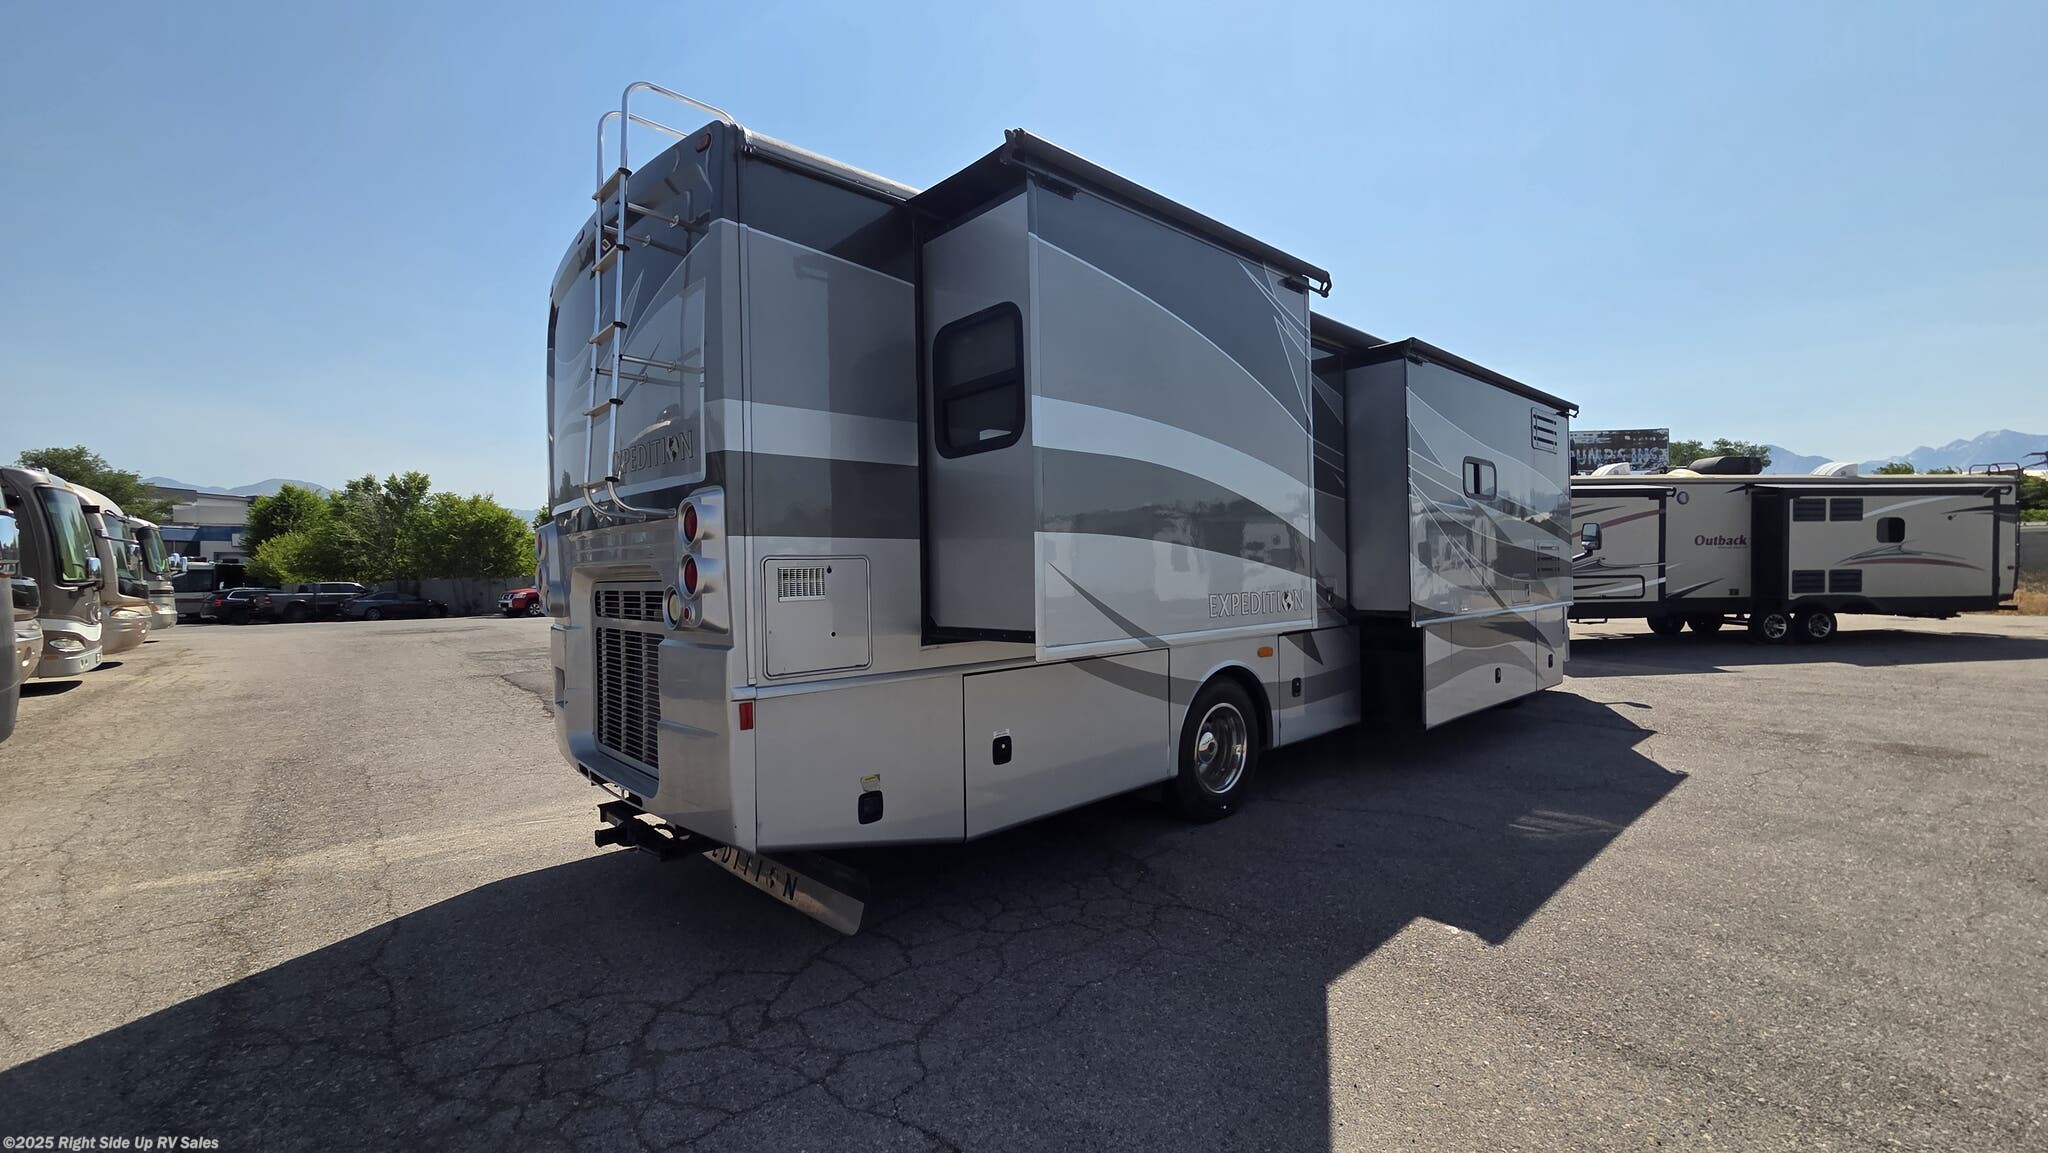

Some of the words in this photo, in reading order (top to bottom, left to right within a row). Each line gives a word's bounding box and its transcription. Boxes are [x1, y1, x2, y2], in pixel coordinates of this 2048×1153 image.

[612, 430, 695, 477] XPEDITION
[1694, 534, 1747, 546] Outback
[1208, 589, 1304, 618] EXPEDITION
